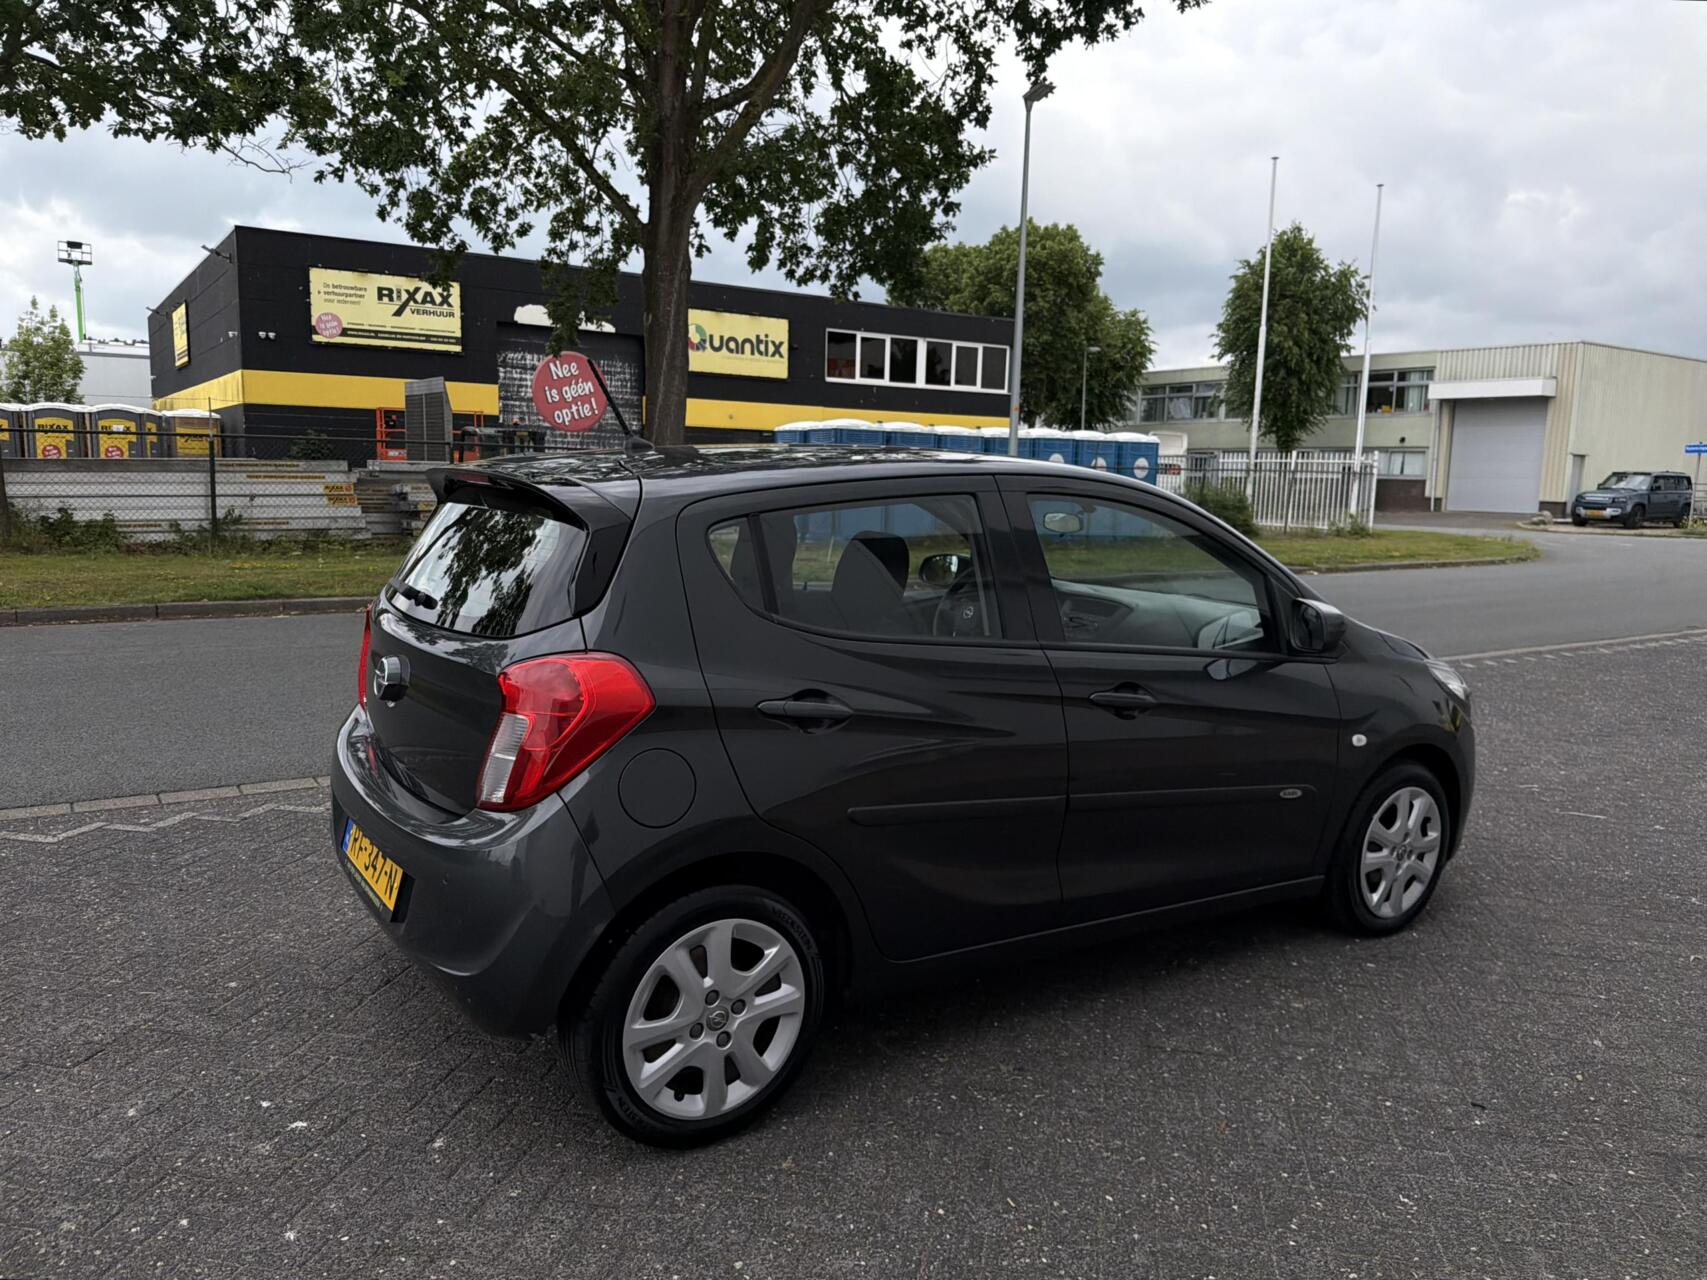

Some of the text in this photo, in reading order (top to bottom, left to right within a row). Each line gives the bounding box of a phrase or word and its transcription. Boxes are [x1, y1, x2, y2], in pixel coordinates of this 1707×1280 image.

[410, 308, 455, 318] VERHUUR
[549, 360, 579, 380] Nee
[545, 378, 594, 403] is géén
[554, 397, 599, 426] optie!
